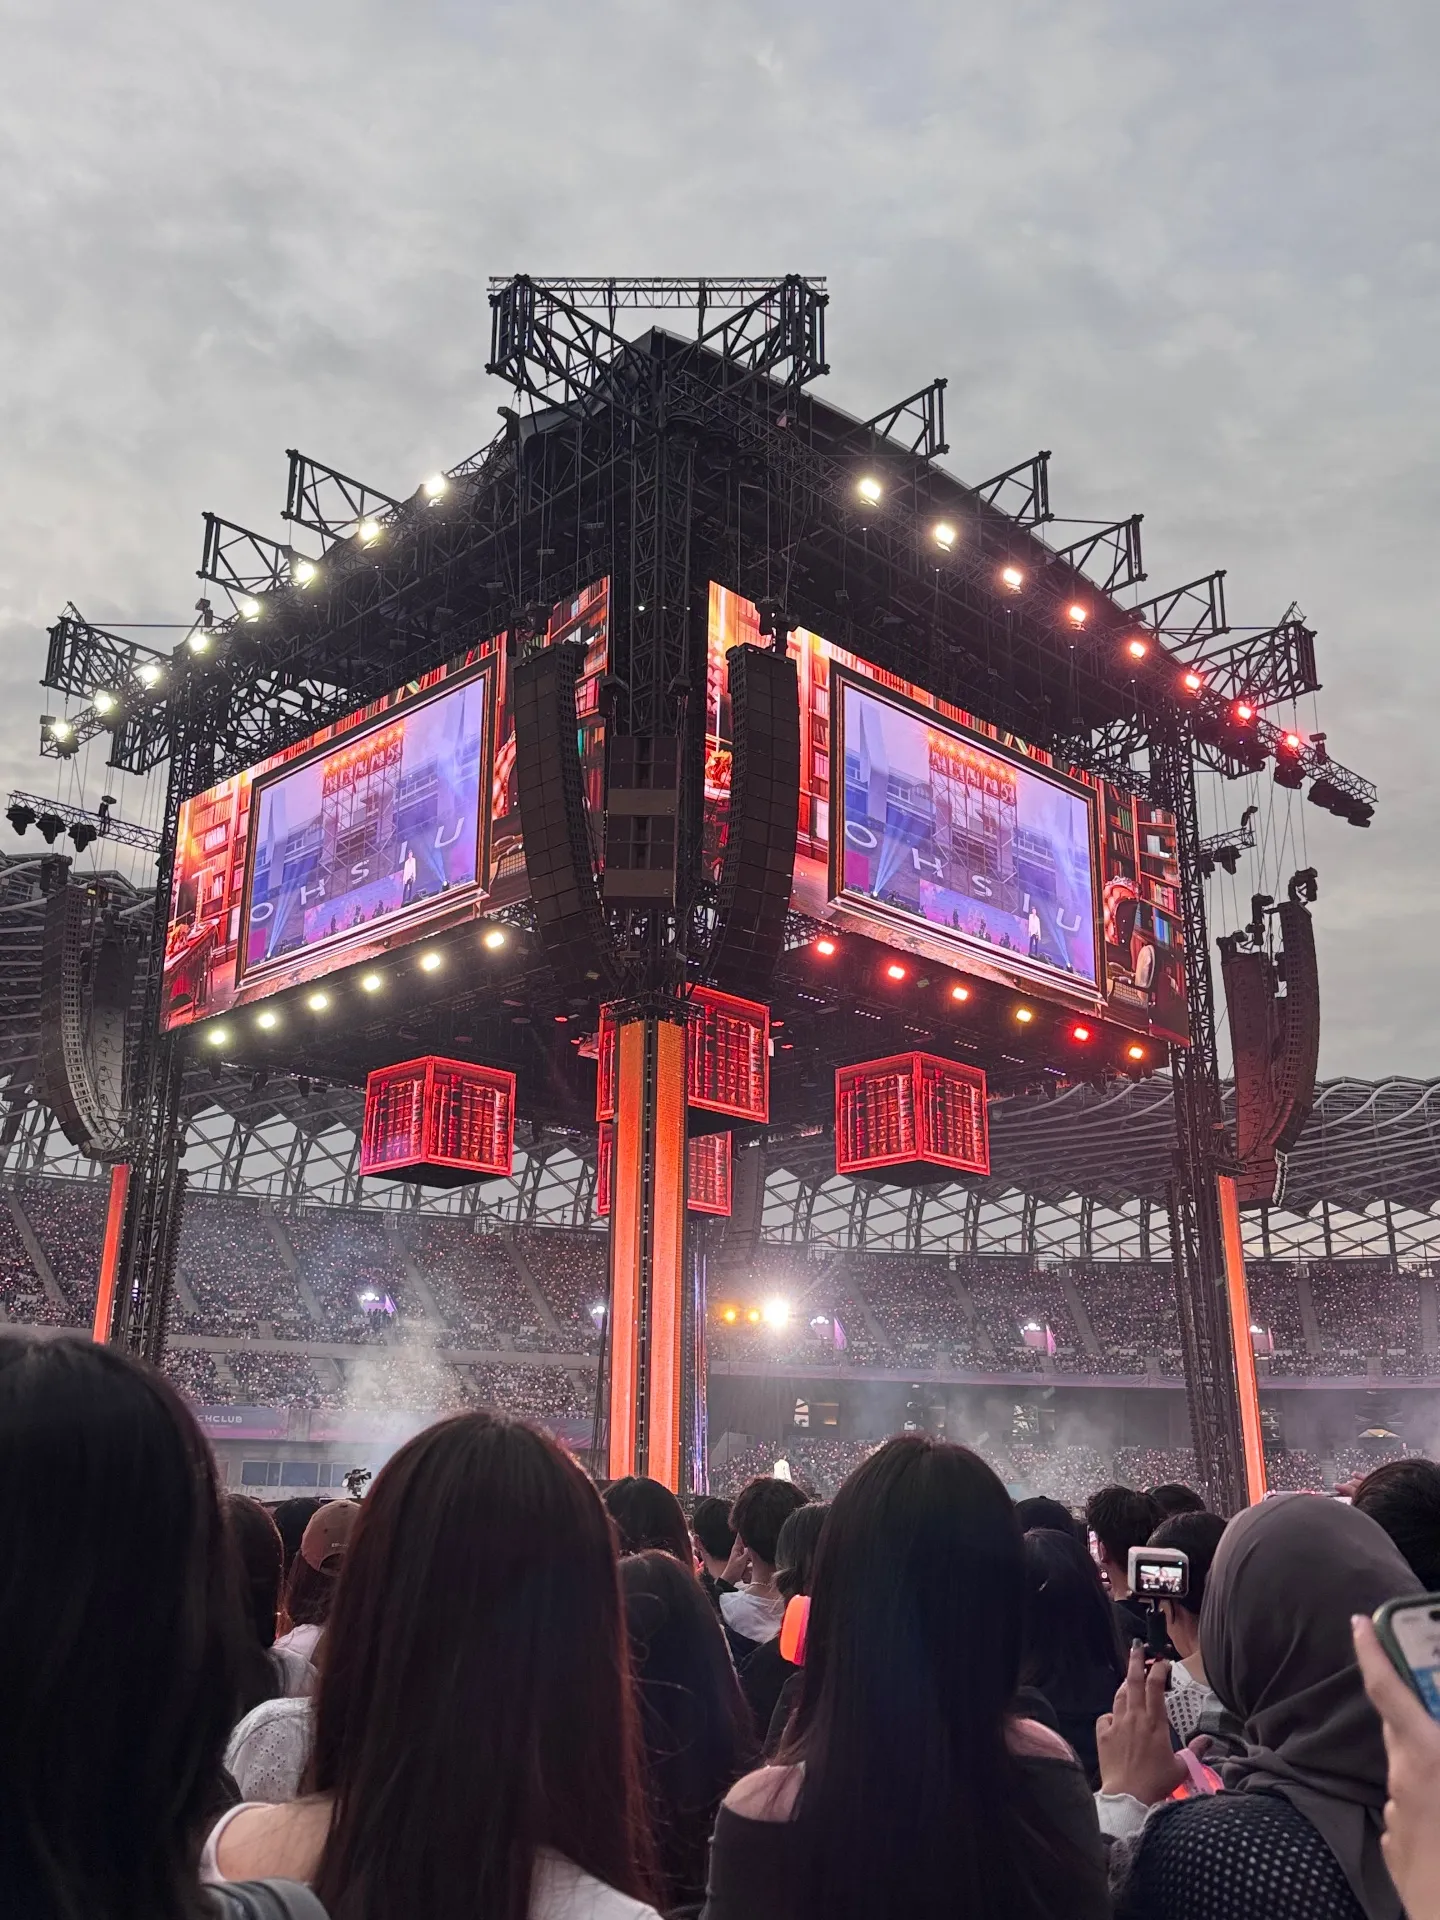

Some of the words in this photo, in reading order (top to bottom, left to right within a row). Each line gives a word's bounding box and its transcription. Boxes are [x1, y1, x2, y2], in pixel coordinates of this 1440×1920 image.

[25, 1177, 53, 1190] C22
[306, 1207, 327, 1217] C24
[400, 1215, 420, 1225] C25
